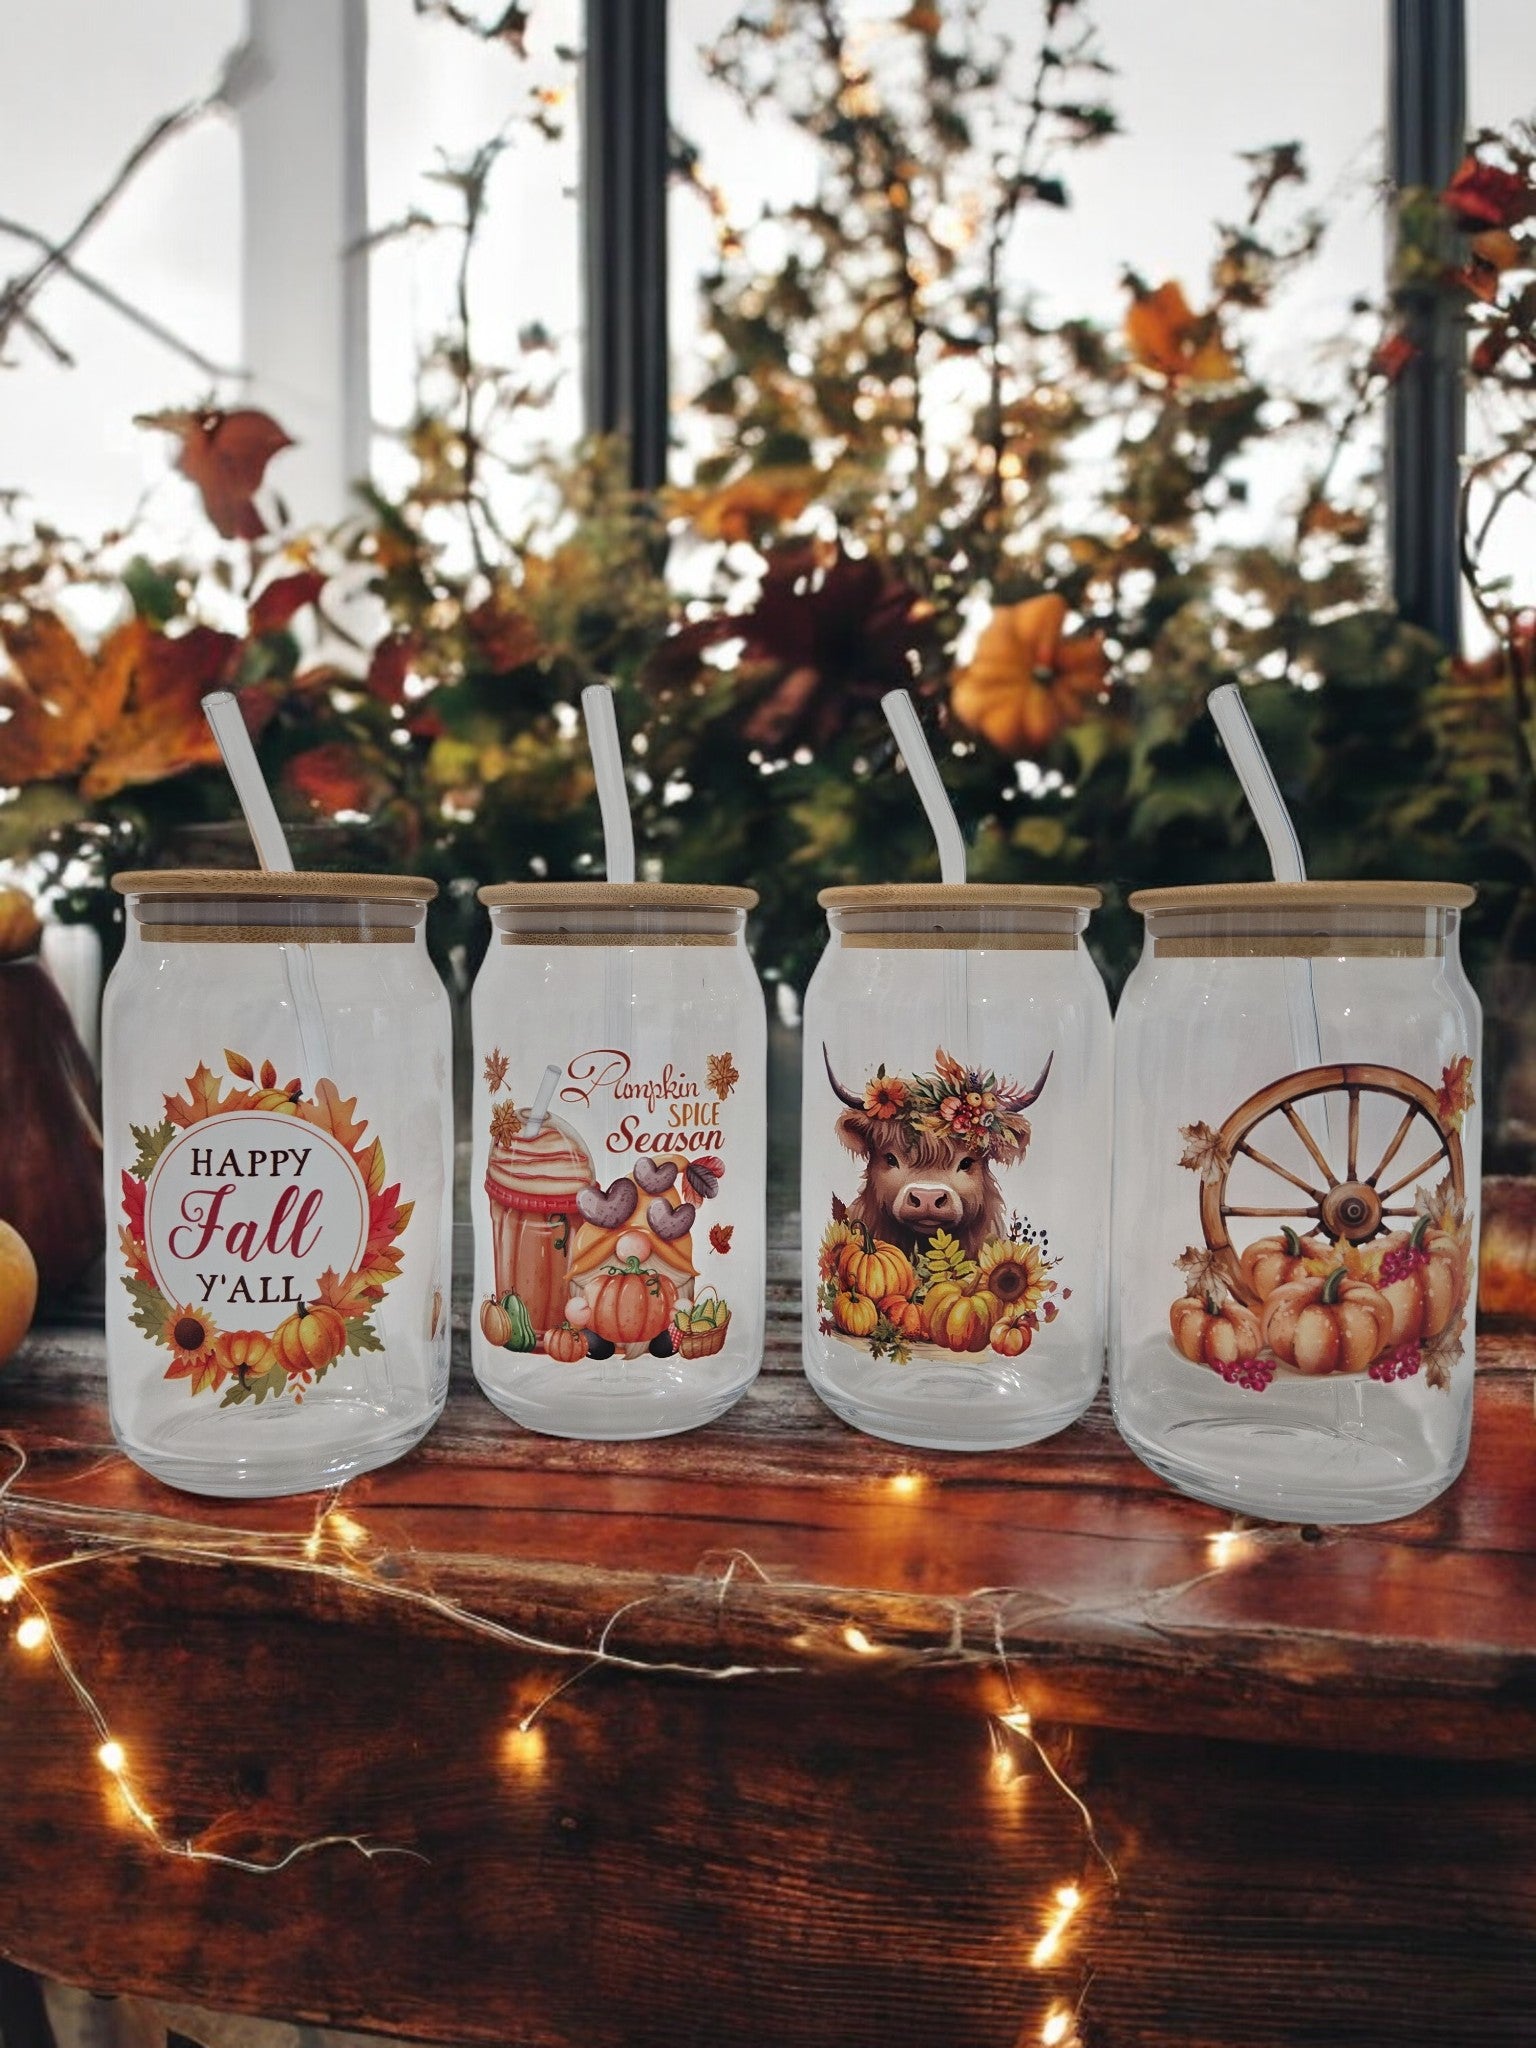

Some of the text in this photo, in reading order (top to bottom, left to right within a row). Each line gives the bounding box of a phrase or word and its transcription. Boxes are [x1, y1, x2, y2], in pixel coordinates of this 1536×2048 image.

[560, 1049, 700, 1113] Pumpkin
[668, 1101, 720, 1128] SPICE
[605, 1114, 725, 1154] Season
[190, 1148, 312, 1177] HAPPY
[168, 1183, 323, 1262] Fall
[196, 1274, 303, 1303] Y'ALL
